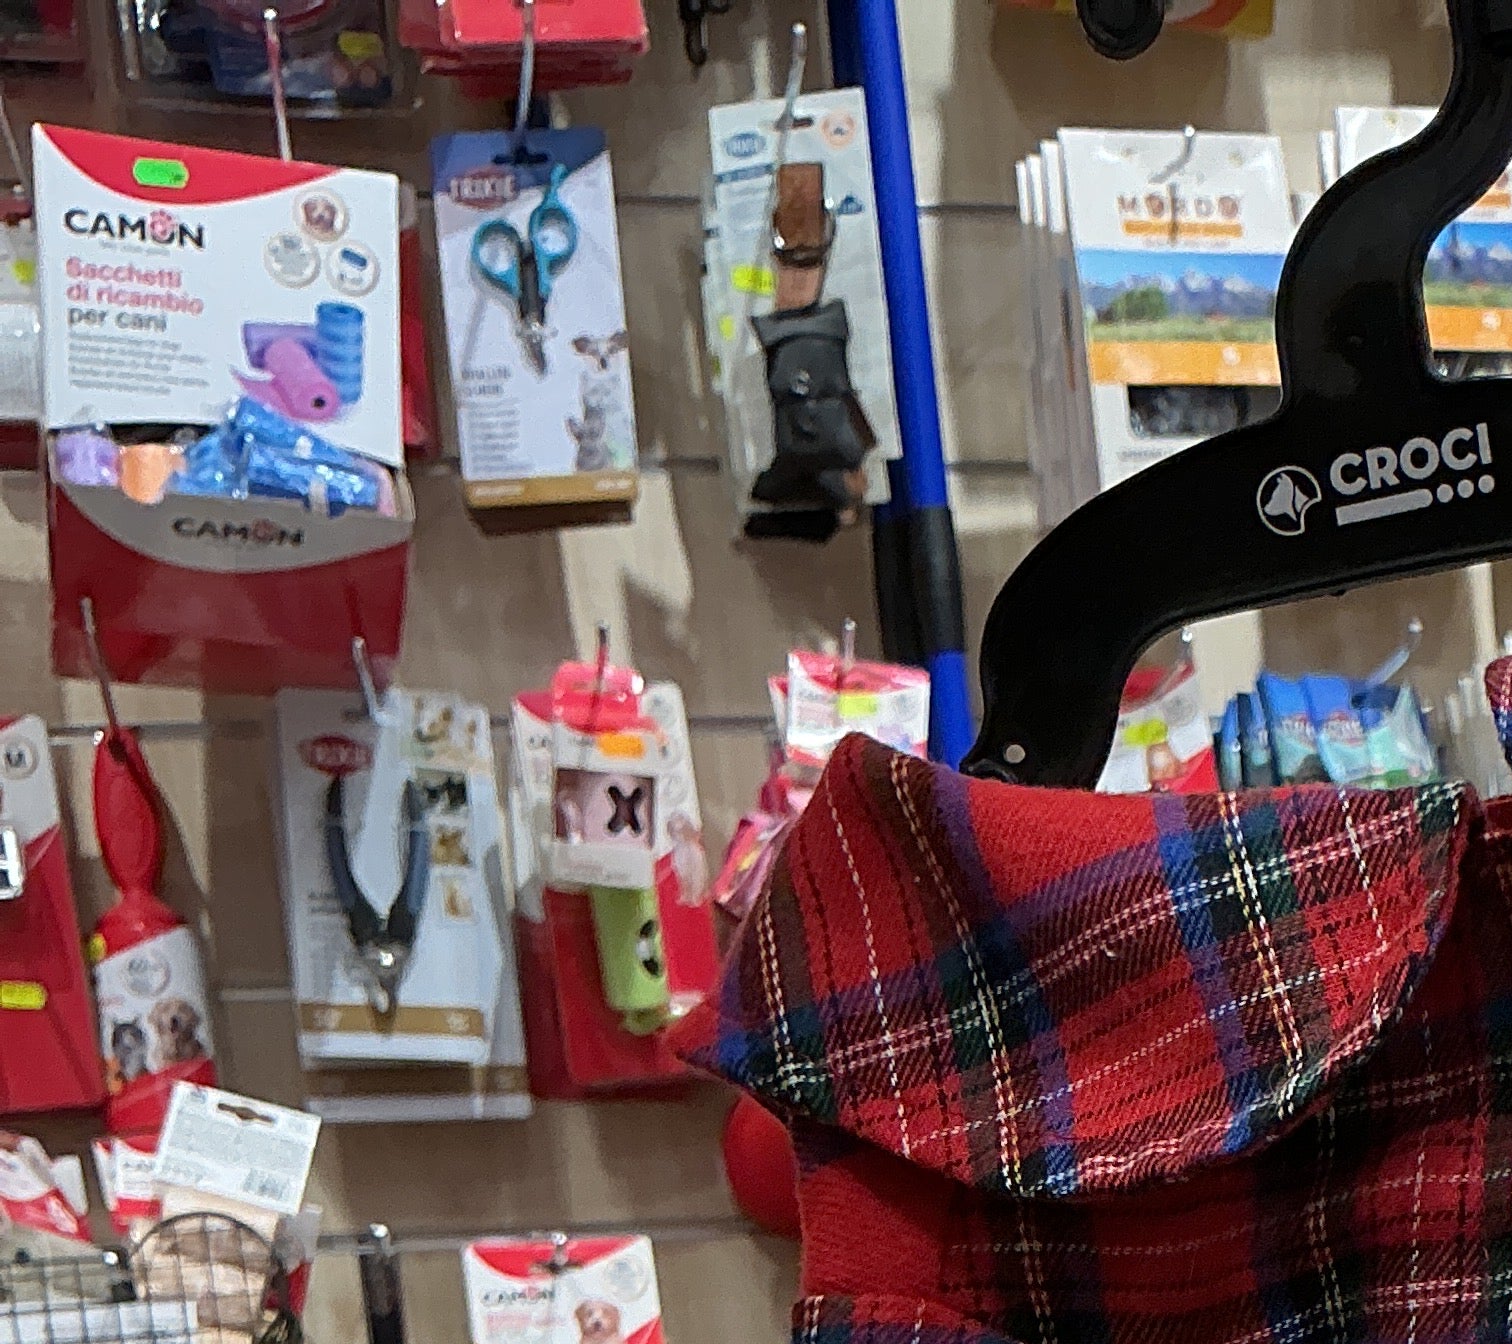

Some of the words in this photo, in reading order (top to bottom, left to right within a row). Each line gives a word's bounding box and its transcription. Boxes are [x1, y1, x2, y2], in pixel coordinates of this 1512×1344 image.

[64, 208, 205, 250] CAMON
[65, 256, 183, 290] Sacchetti
[66, 284, 90, 302] di
[96, 286, 204, 316] ricambio
[68, 307, 107, 328] per
[115, 309, 167, 333] cani
[1330, 422, 1493, 496] CROCI
